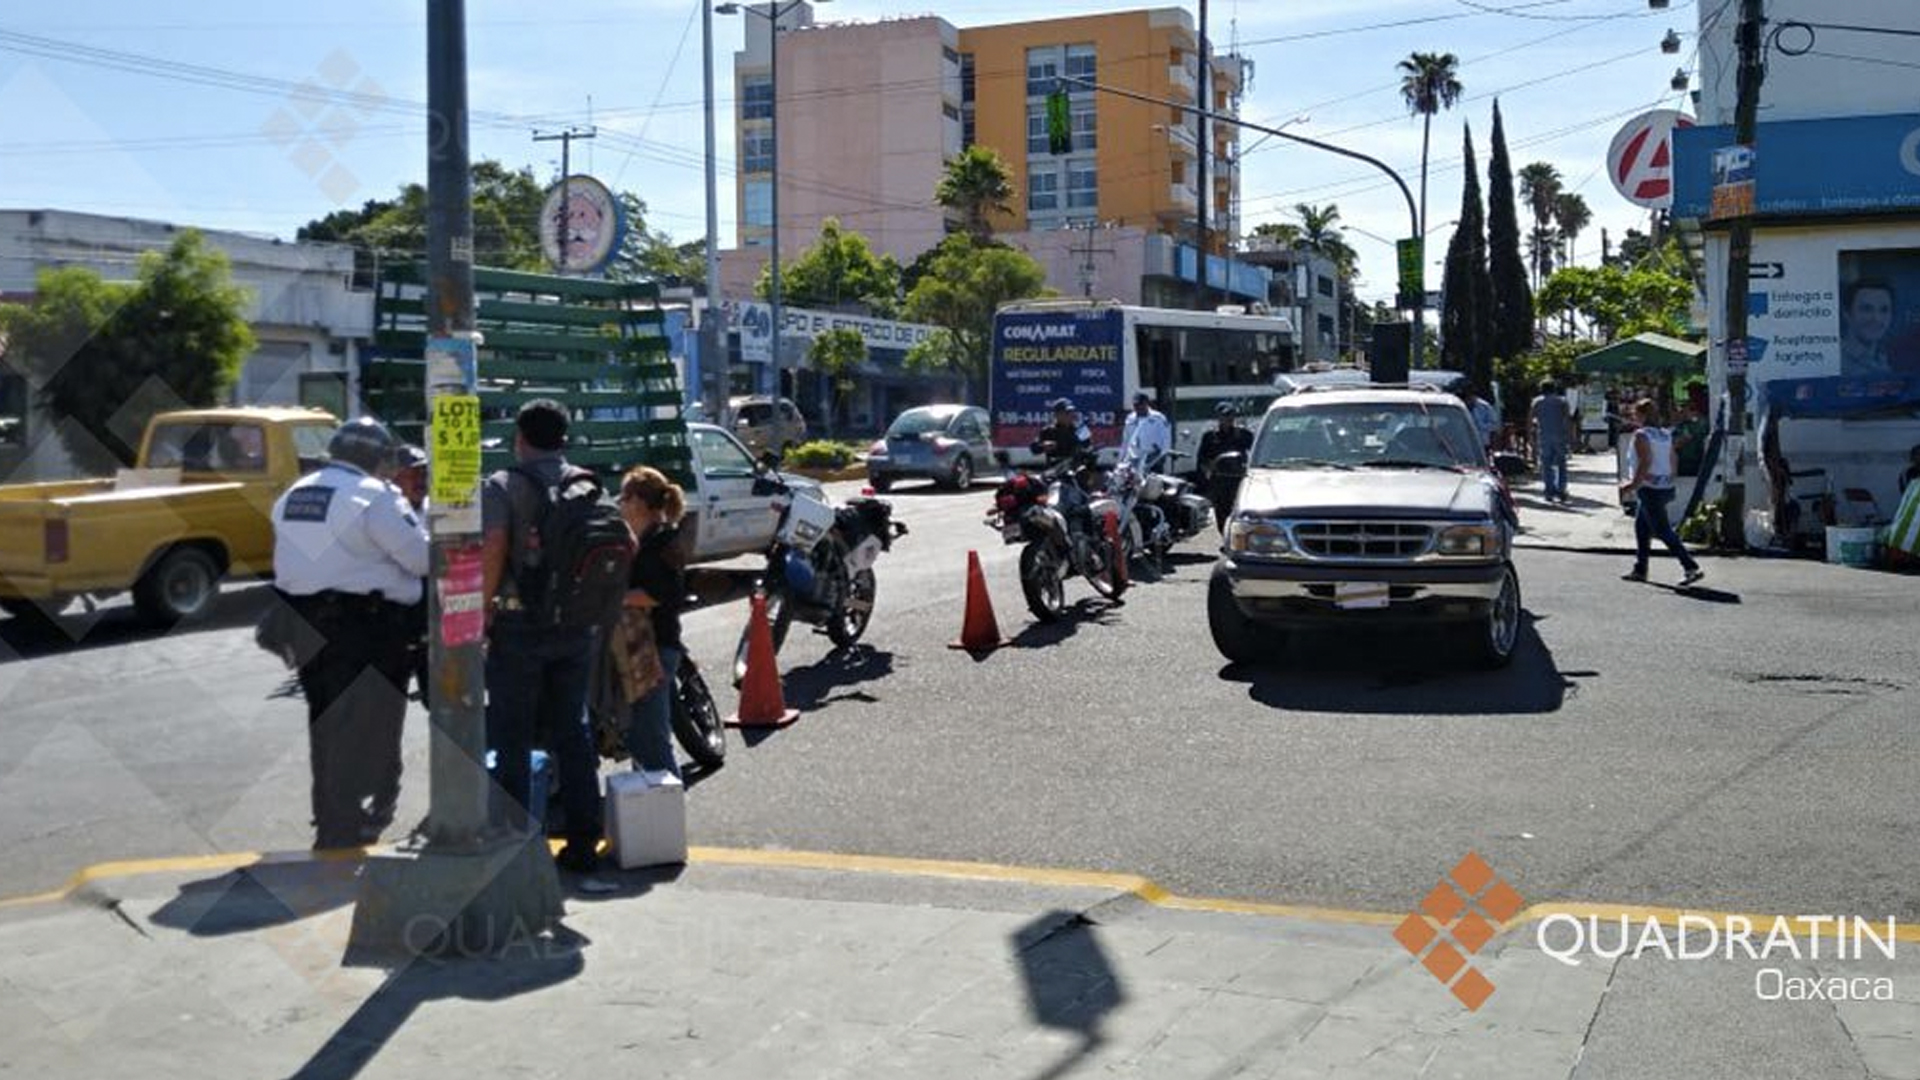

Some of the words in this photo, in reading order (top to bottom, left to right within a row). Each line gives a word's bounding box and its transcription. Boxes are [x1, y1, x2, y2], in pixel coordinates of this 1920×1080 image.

[1771, 290, 1821, 305] Entrega
[1823, 292, 1834, 301] a
[1773, 306, 1833, 319] domicilio
[1003, 324, 1075, 341] CONAMAT
[1773, 334, 1838, 347] Aceptamos
[1003, 346, 1117, 362] REGULARIZATE
[1774, 350, 1824, 366] tarjetas
